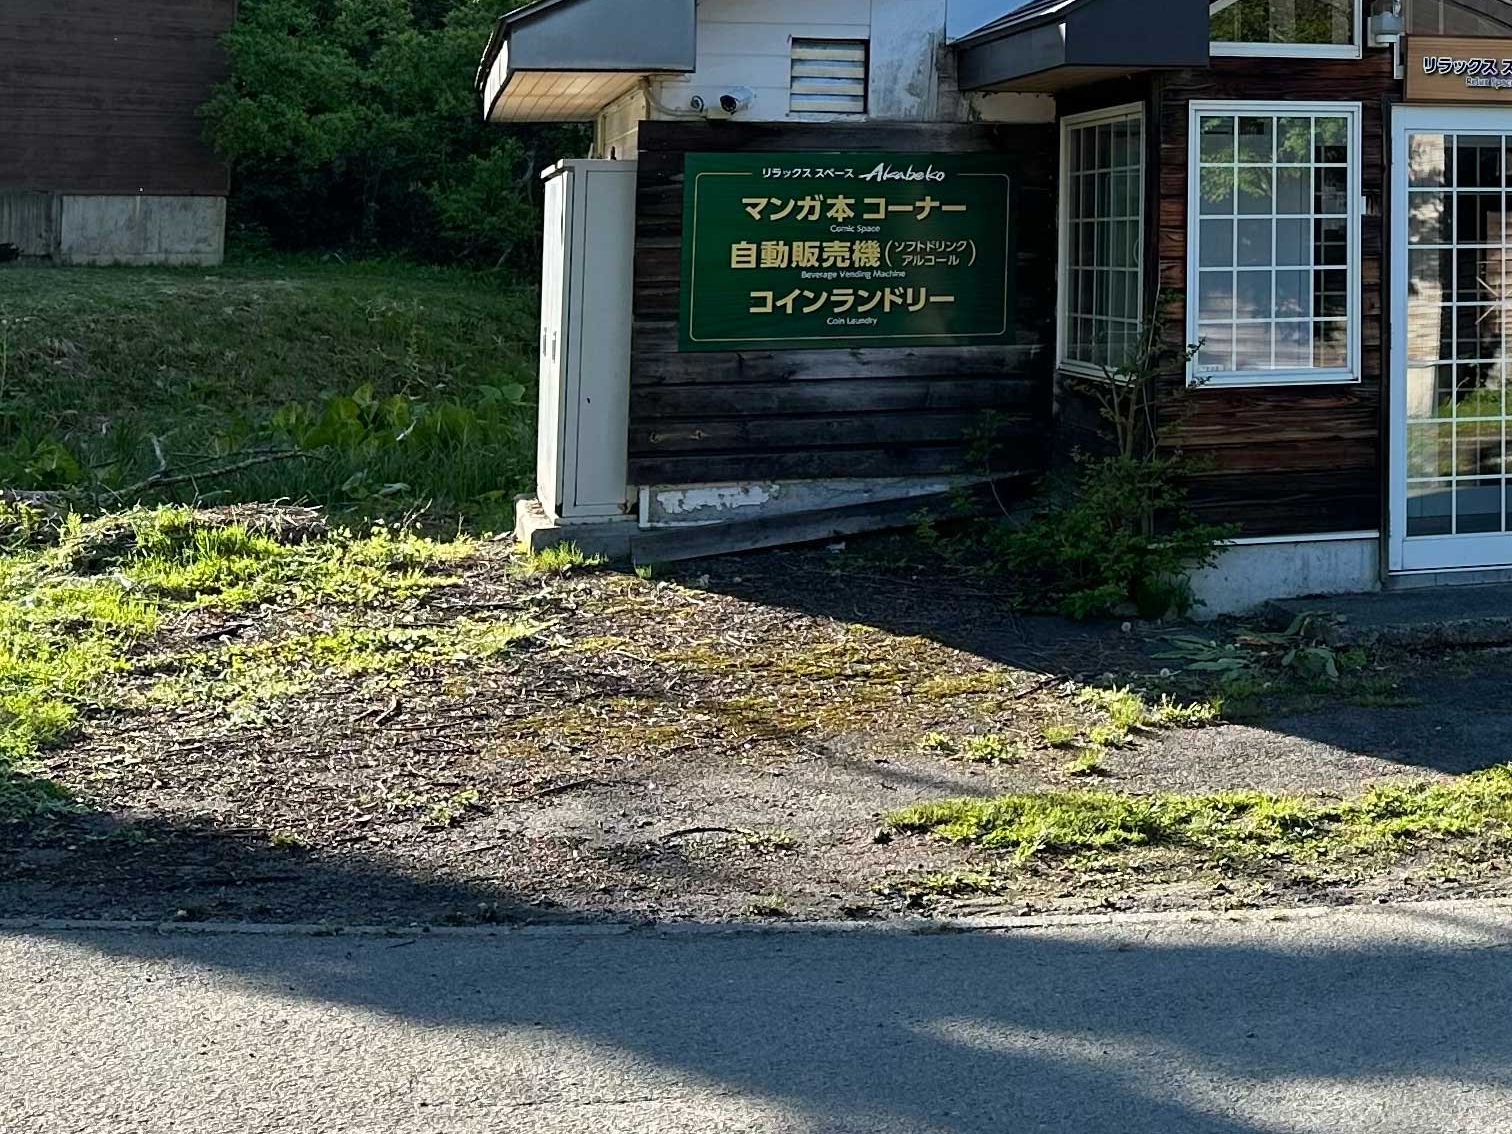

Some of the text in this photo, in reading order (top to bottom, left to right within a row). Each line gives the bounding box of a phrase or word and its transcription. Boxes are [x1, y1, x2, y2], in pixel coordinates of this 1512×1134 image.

[1423, 56, 1497, 76] リラックス
[762, 167, 855, 179] リラックス スペース
[858, 162, 946, 182] Akabeko
[741, 193, 967, 223] マンガ本 コーナー
[830, 225, 881, 234] Comic Space
[894, 240, 968, 253] ソフトドリンク
[730, 240, 881, 268] 自動販売機
[901, 254, 960, 267] アルコール
[801, 270, 906, 280] Beverage Vending Machine
[749, 286, 955, 314] コインランドリー
[826, 317, 878, 326] Coin Laundry
